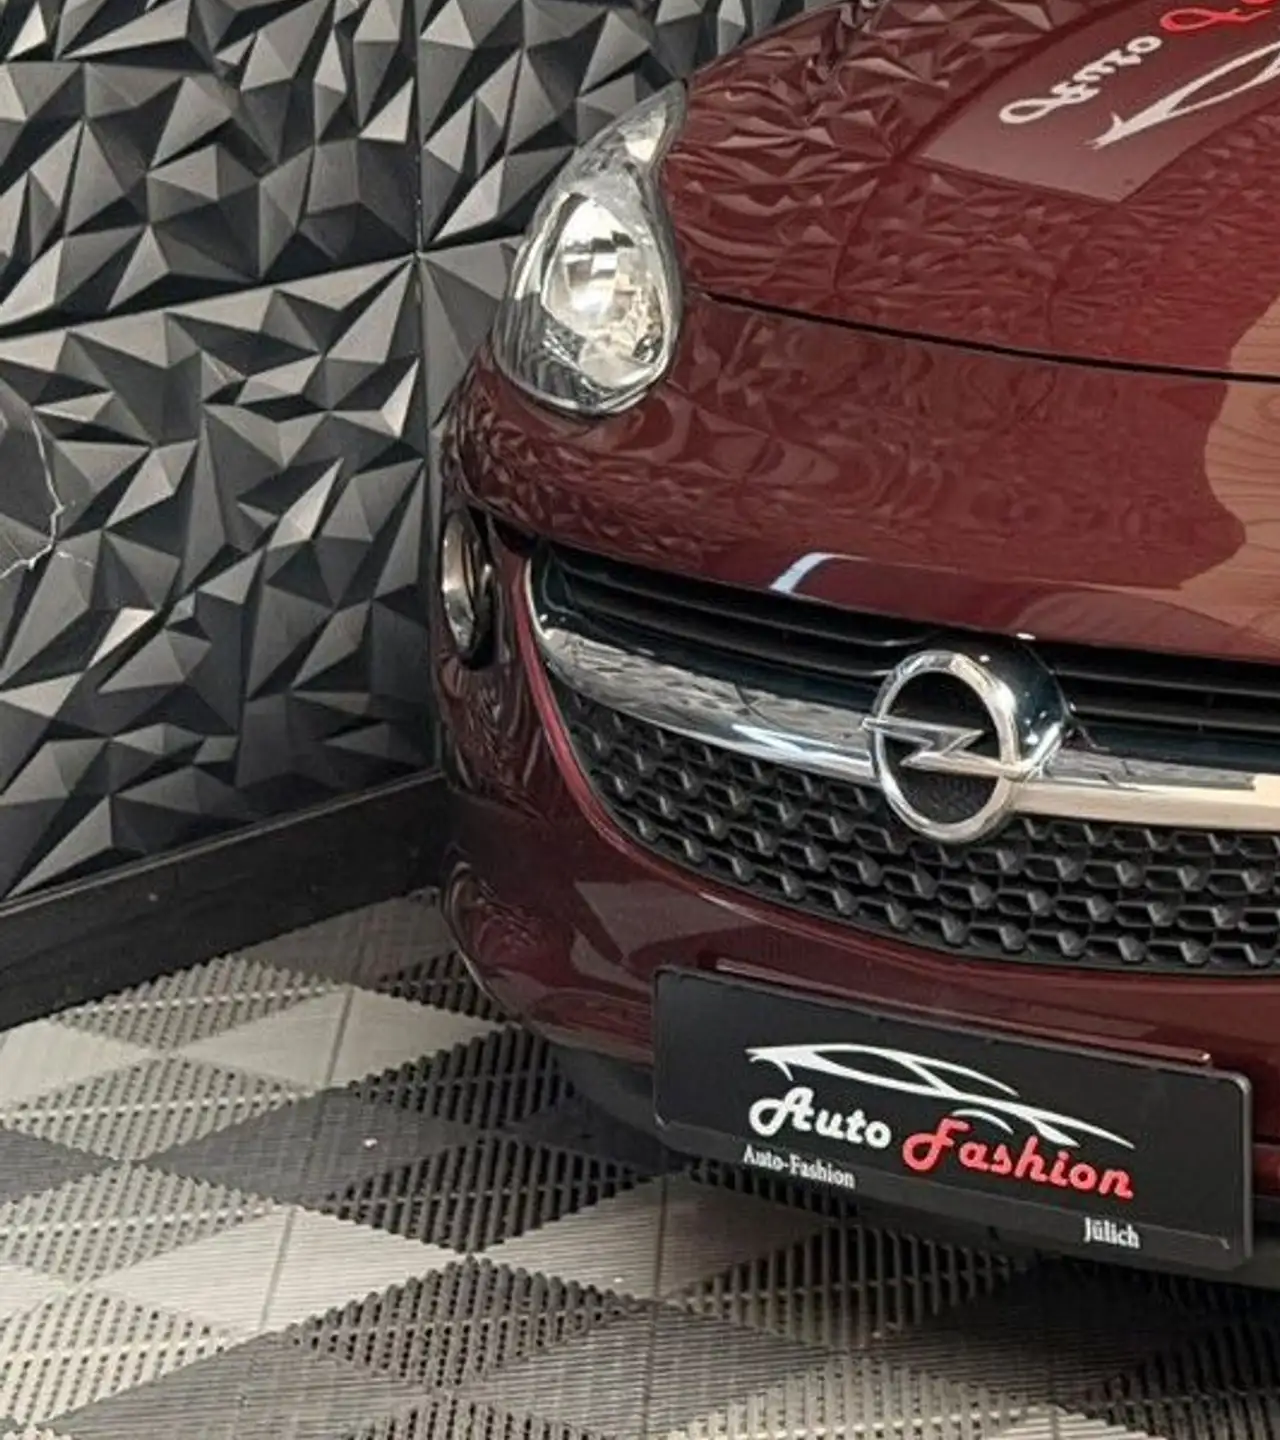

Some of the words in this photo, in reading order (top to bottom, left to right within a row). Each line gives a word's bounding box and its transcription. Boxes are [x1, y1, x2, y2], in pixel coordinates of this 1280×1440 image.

[742, 1143, 857, 1190] Auto-Fashion
[748, 1085, 893, 1150] Auto
[902, 1117, 1136, 1202] Fashion
[1082, 1215, 1142, 1250] Jülich
